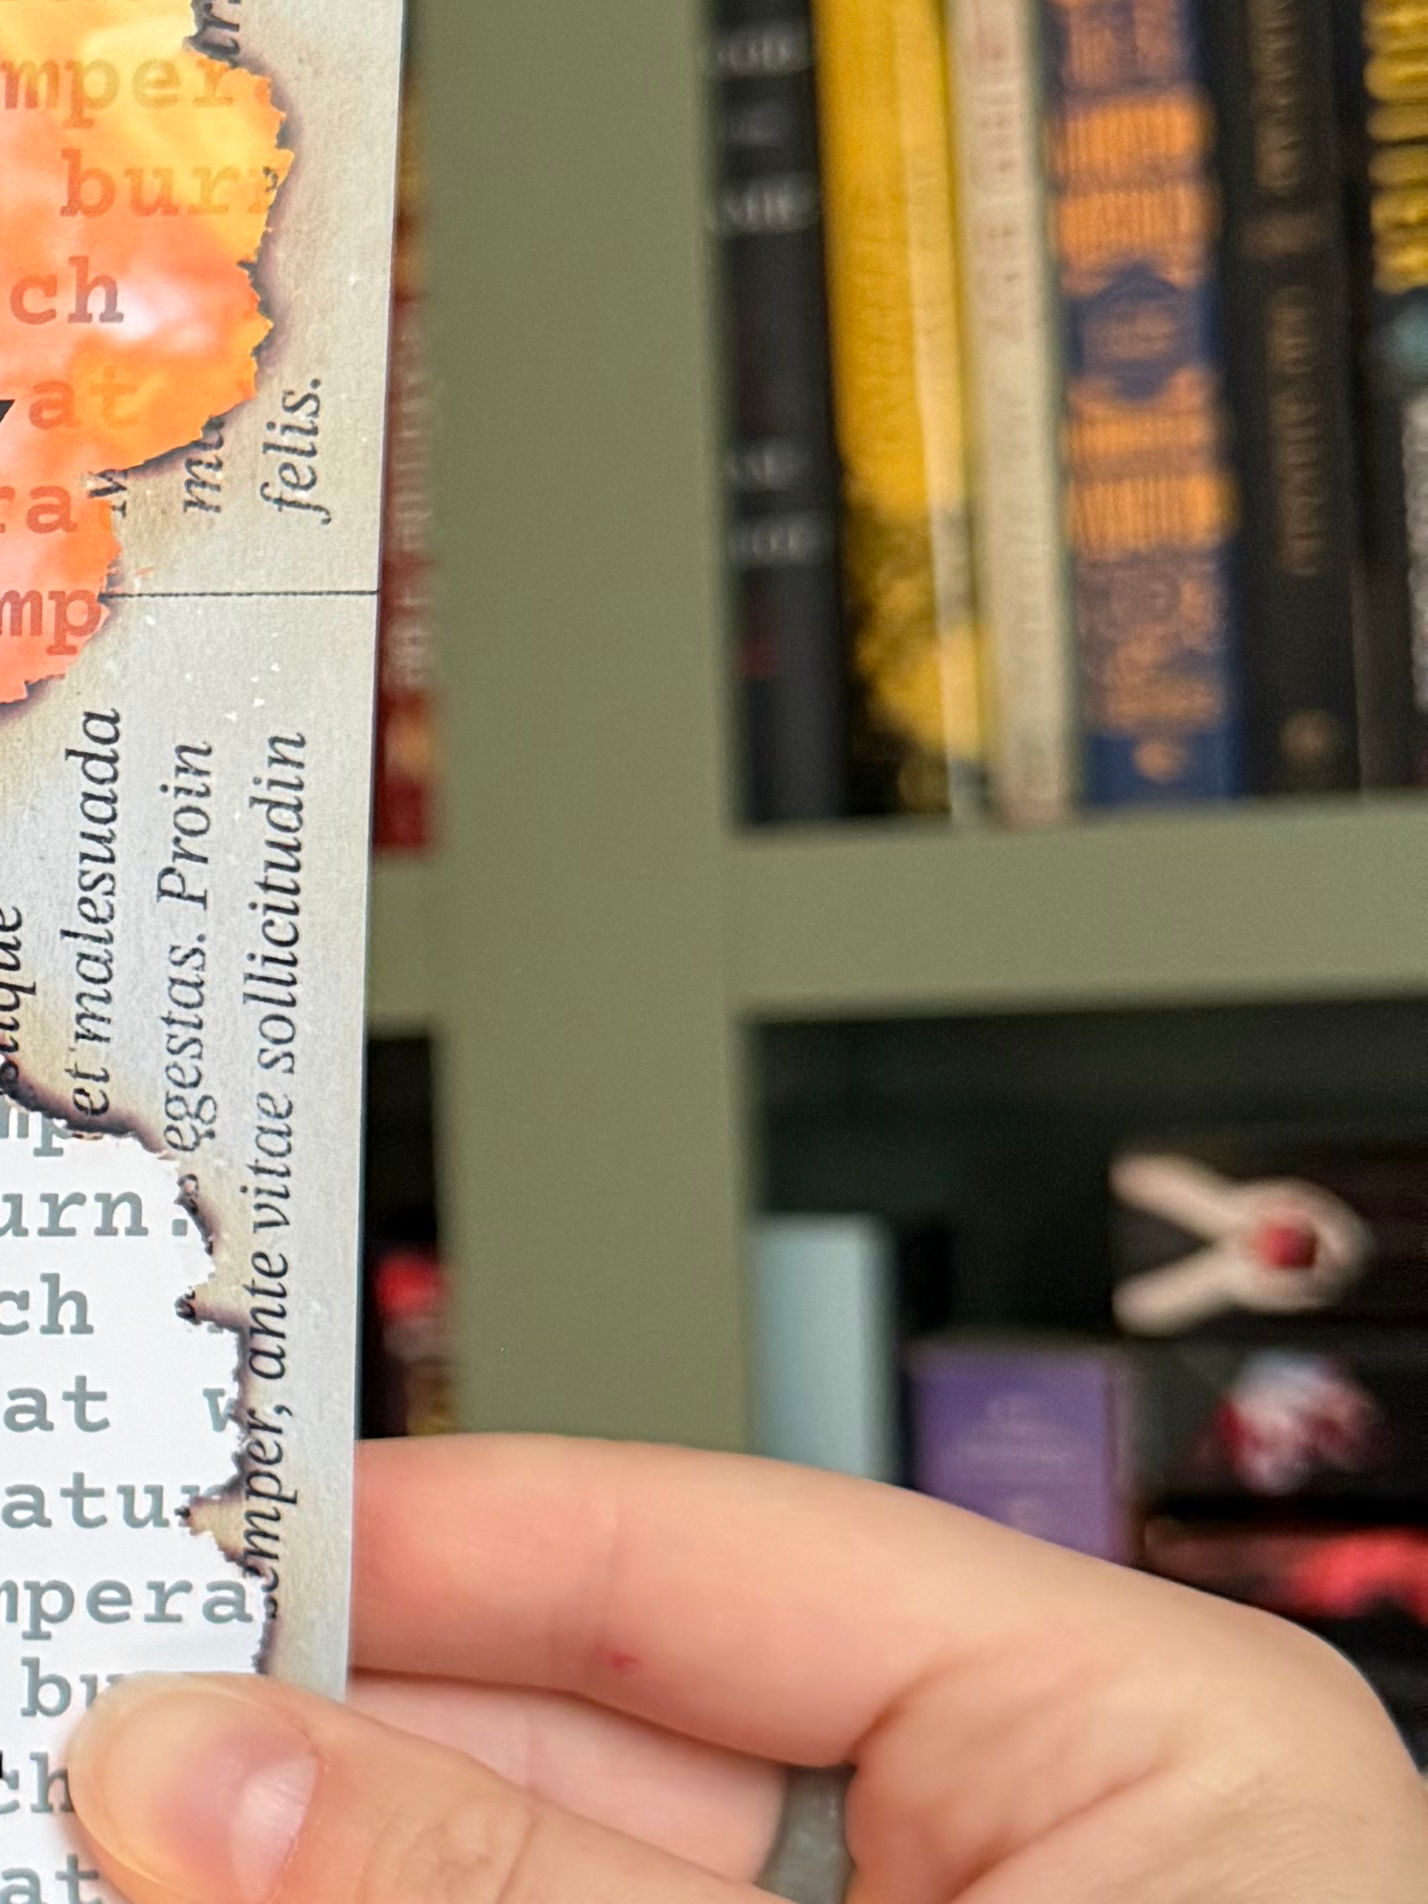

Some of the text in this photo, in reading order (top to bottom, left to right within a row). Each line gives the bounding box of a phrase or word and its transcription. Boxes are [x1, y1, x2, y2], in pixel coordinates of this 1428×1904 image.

[28, 365, 139, 431] at
[259, 377, 331, 525] felis.
[59, 706, 121, 1119] et malesuada
[156, 739, 218, 1154] egestas. Proin
[238, 730, 307, 1382] ante vitae sollicitudin
[2, 1376, 111, 1435] at
